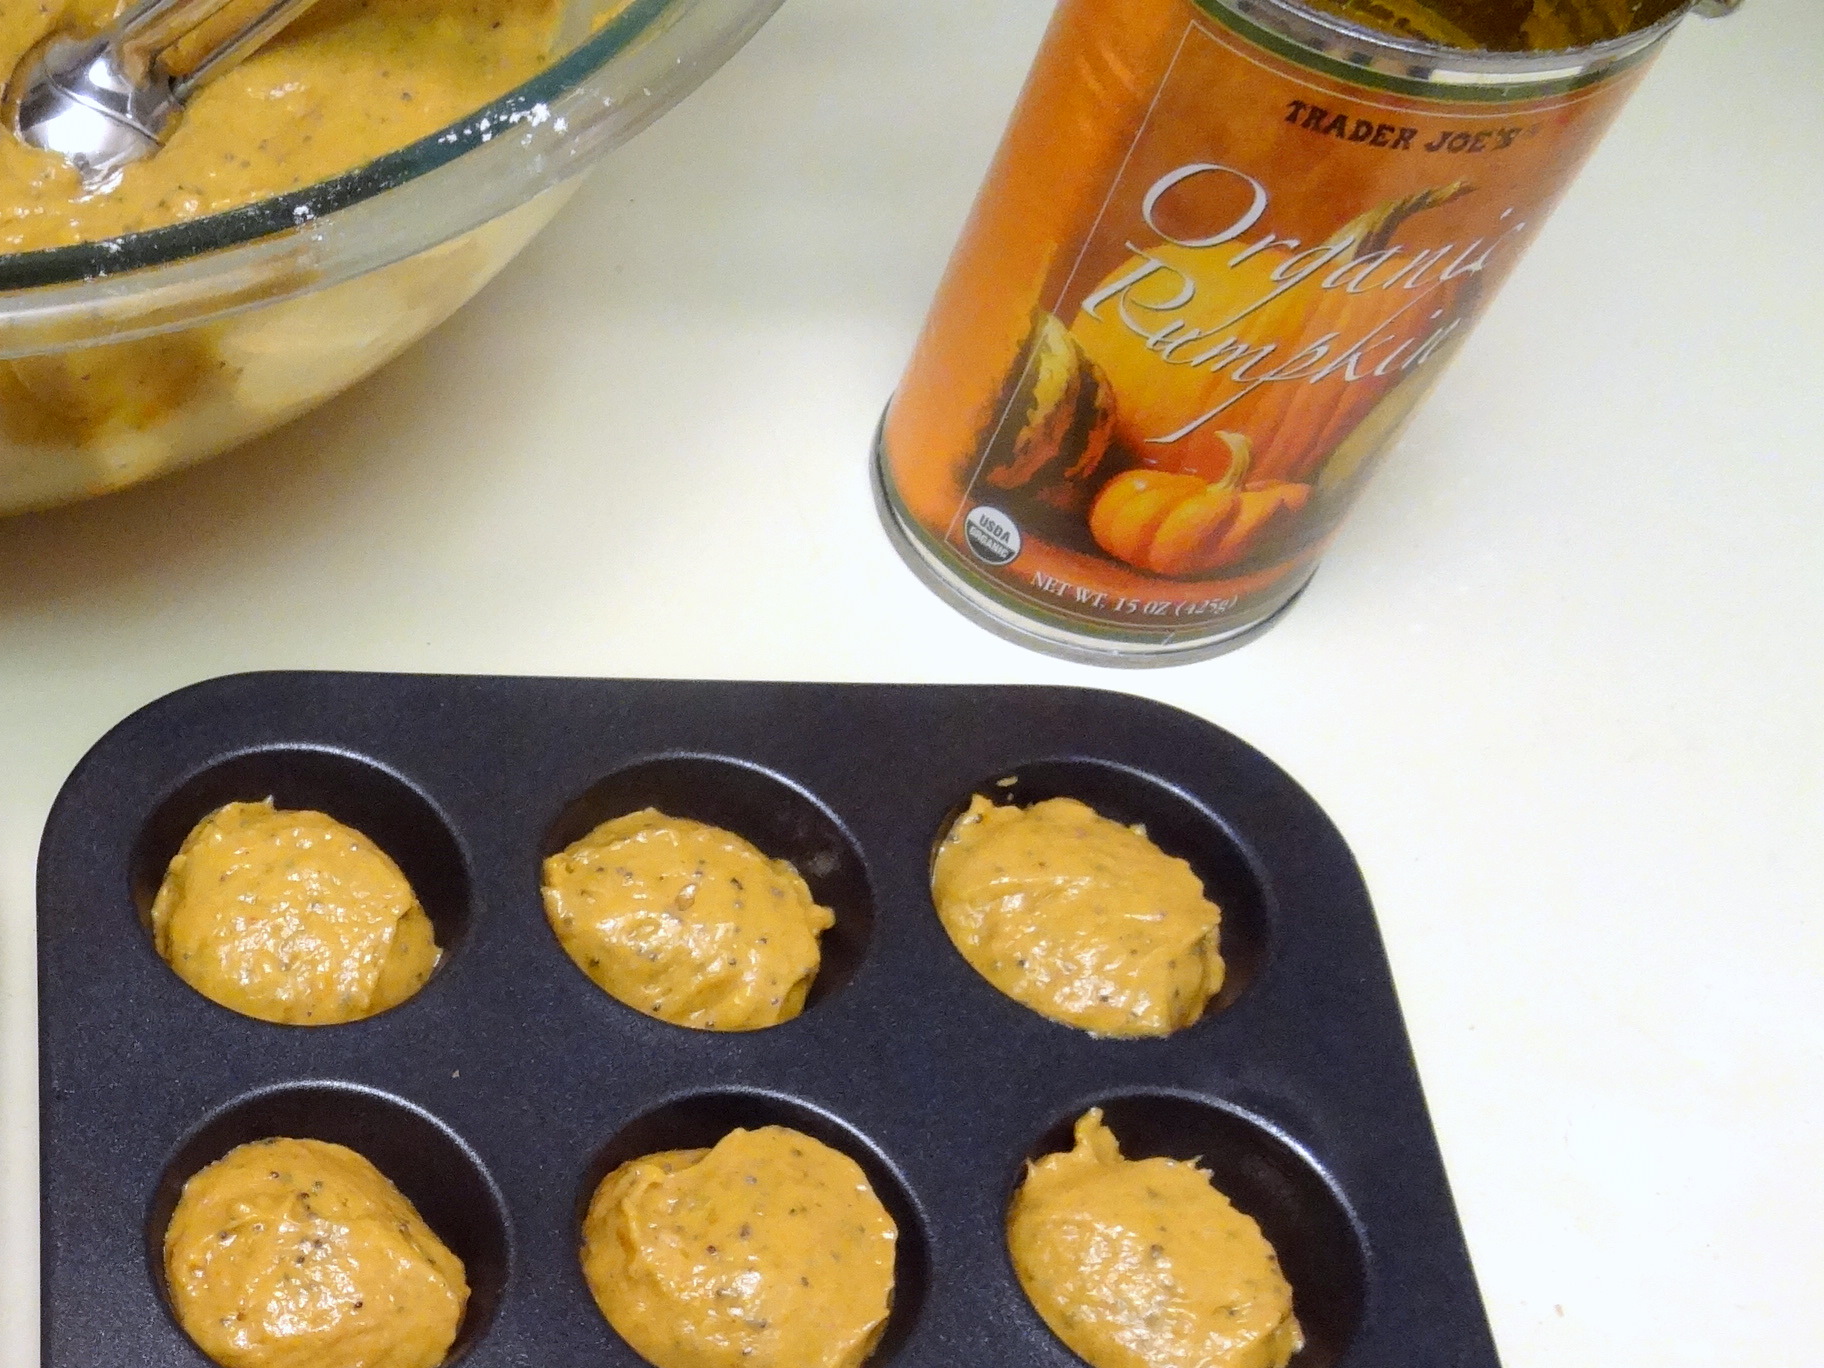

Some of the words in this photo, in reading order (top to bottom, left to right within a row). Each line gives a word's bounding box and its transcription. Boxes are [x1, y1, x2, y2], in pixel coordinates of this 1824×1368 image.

[1284, 99, 1418, 150] TRADER
[1424, 127, 1523, 153] JOE'S
[1141, 162, 1526, 338] Organic
[1081, 240, 1462, 444] Pumpkin
[968, 525, 1010, 558] ORGANIC
[978, 513, 1011, 545] USDA
[1029, 570, 1073, 597] NET
[1113, 596, 1141, 614] 15
[1142, 600, 1172, 617] OZ
[1174, 594, 1240, 618] (425g)
